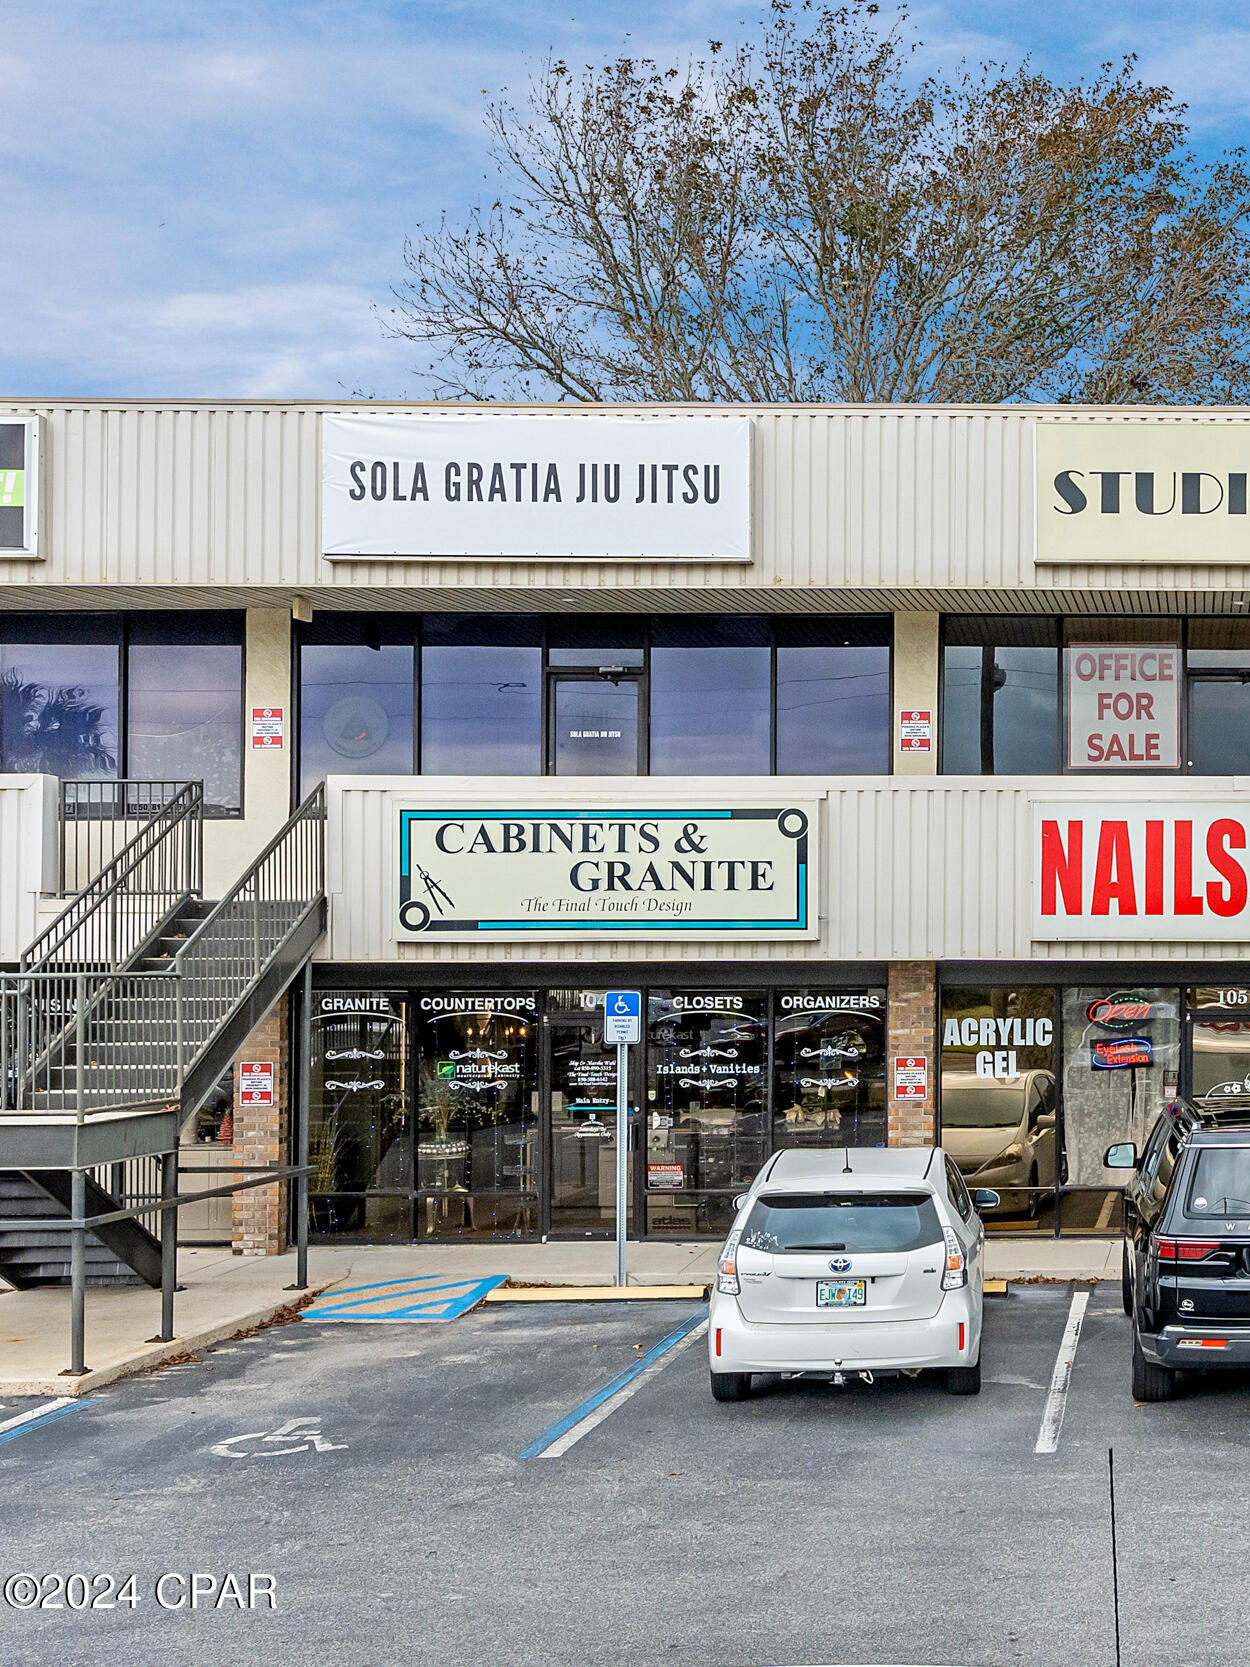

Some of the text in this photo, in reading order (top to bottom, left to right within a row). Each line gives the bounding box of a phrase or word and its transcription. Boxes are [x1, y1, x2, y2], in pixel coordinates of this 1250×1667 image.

[349, 461, 720, 504] SOLA GRATIA JIU JITSU
[1075, 653, 1174, 681] OFFICE
[1097, 692, 1155, 721] FOR
[1087, 733, 1161, 762] SALE
[434, 822, 708, 854] CABINETS &
[569, 860, 775, 892] GRANITE
[1041, 818, 1248, 918] NAILS
[520, 897, 693, 916] The Final Touch Design
[321, 998, 389, 1010] GRANITE
[420, 997, 536, 1010] COUNTERTOPS
[672, 996, 743, 1009] CLOSETS
[781, 996, 880, 1008] ORGANIZERS
[1217, 990, 1248, 1005] 105
[1089, 999, 1151, 1023] Open
[943, 1018, 1053, 1046] ACRYLIC
[1096, 1043, 1138, 1057] Eyelash
[1106, 1053, 1149, 1065] Extension
[456, 1061, 520, 1073] naturekast
[656, 1064, 700, 1074] Islands
[709, 1064, 760, 1074] Vanities
[976, 1051, 1021, 1079] GEL
[652, 1215, 691, 1226] atlas
